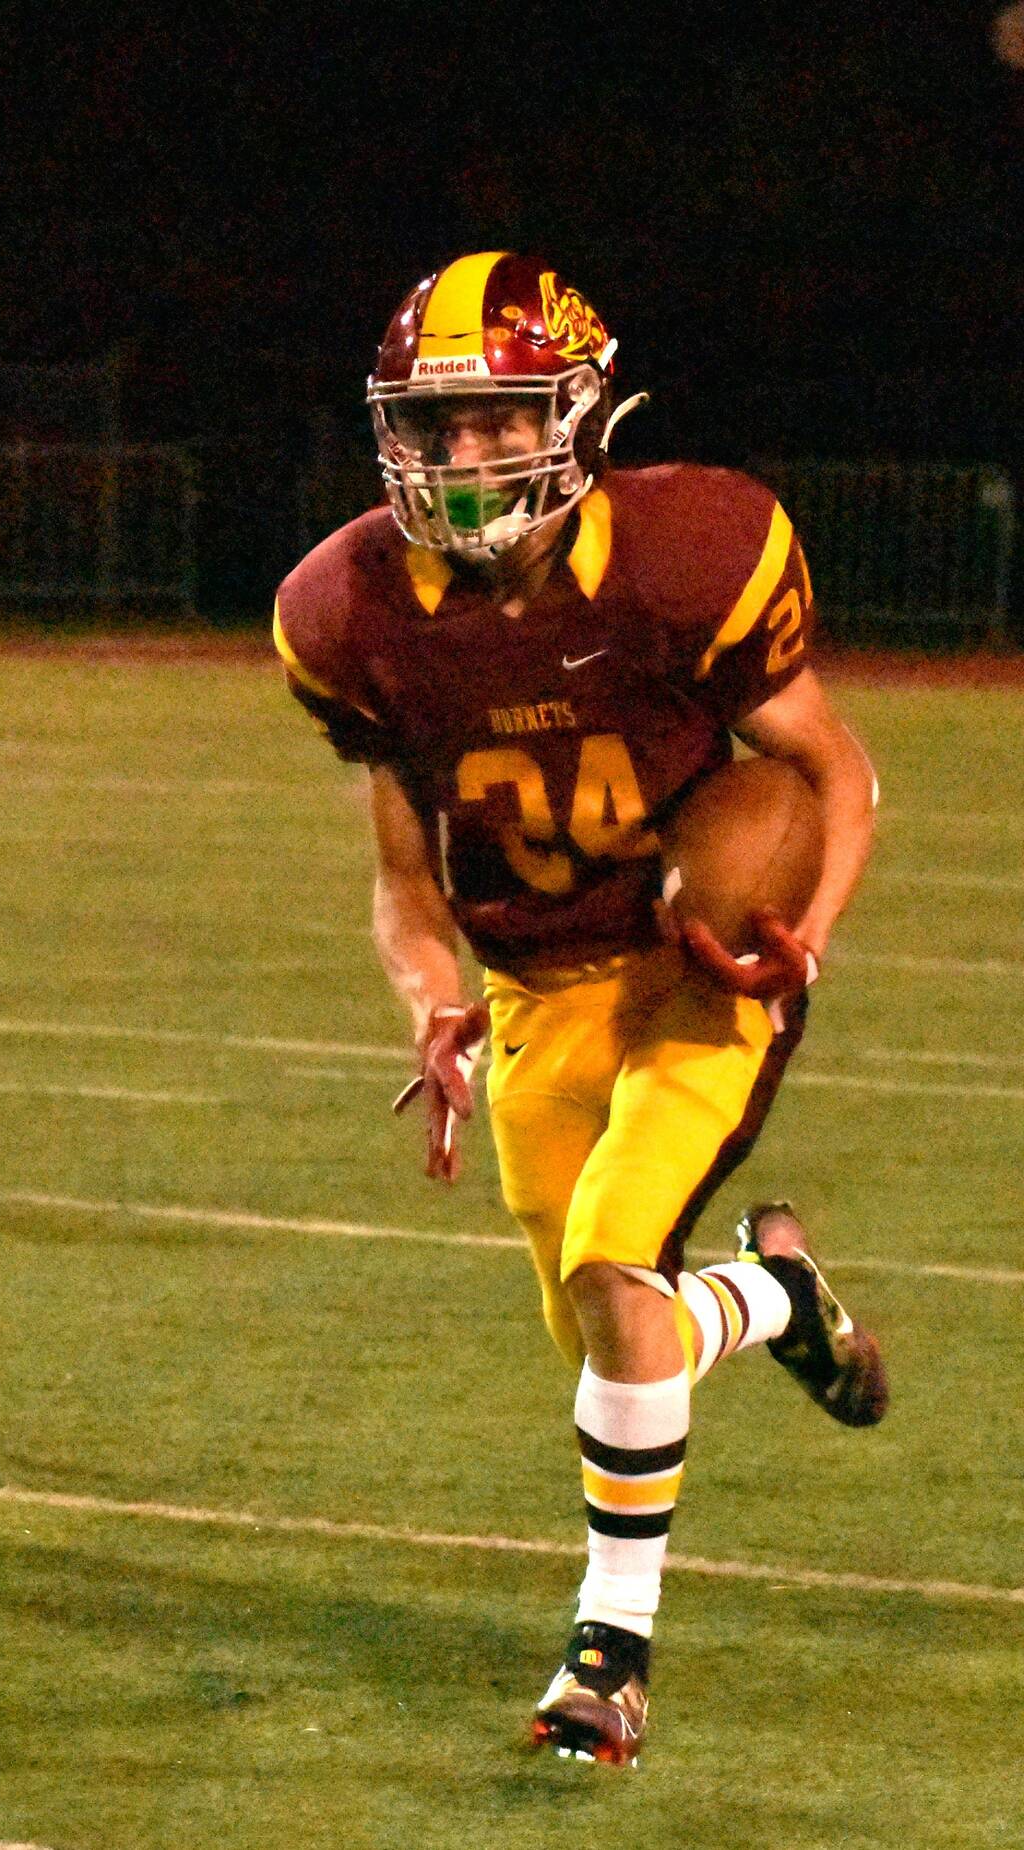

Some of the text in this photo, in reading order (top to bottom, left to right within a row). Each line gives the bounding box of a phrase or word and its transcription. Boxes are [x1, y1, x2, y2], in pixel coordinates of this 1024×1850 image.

[418, 358, 477, 376] Riddell
[765, 587, 805, 673] 2
[489, 702, 576, 734] HORNETS
[456, 733, 662, 894] 24
